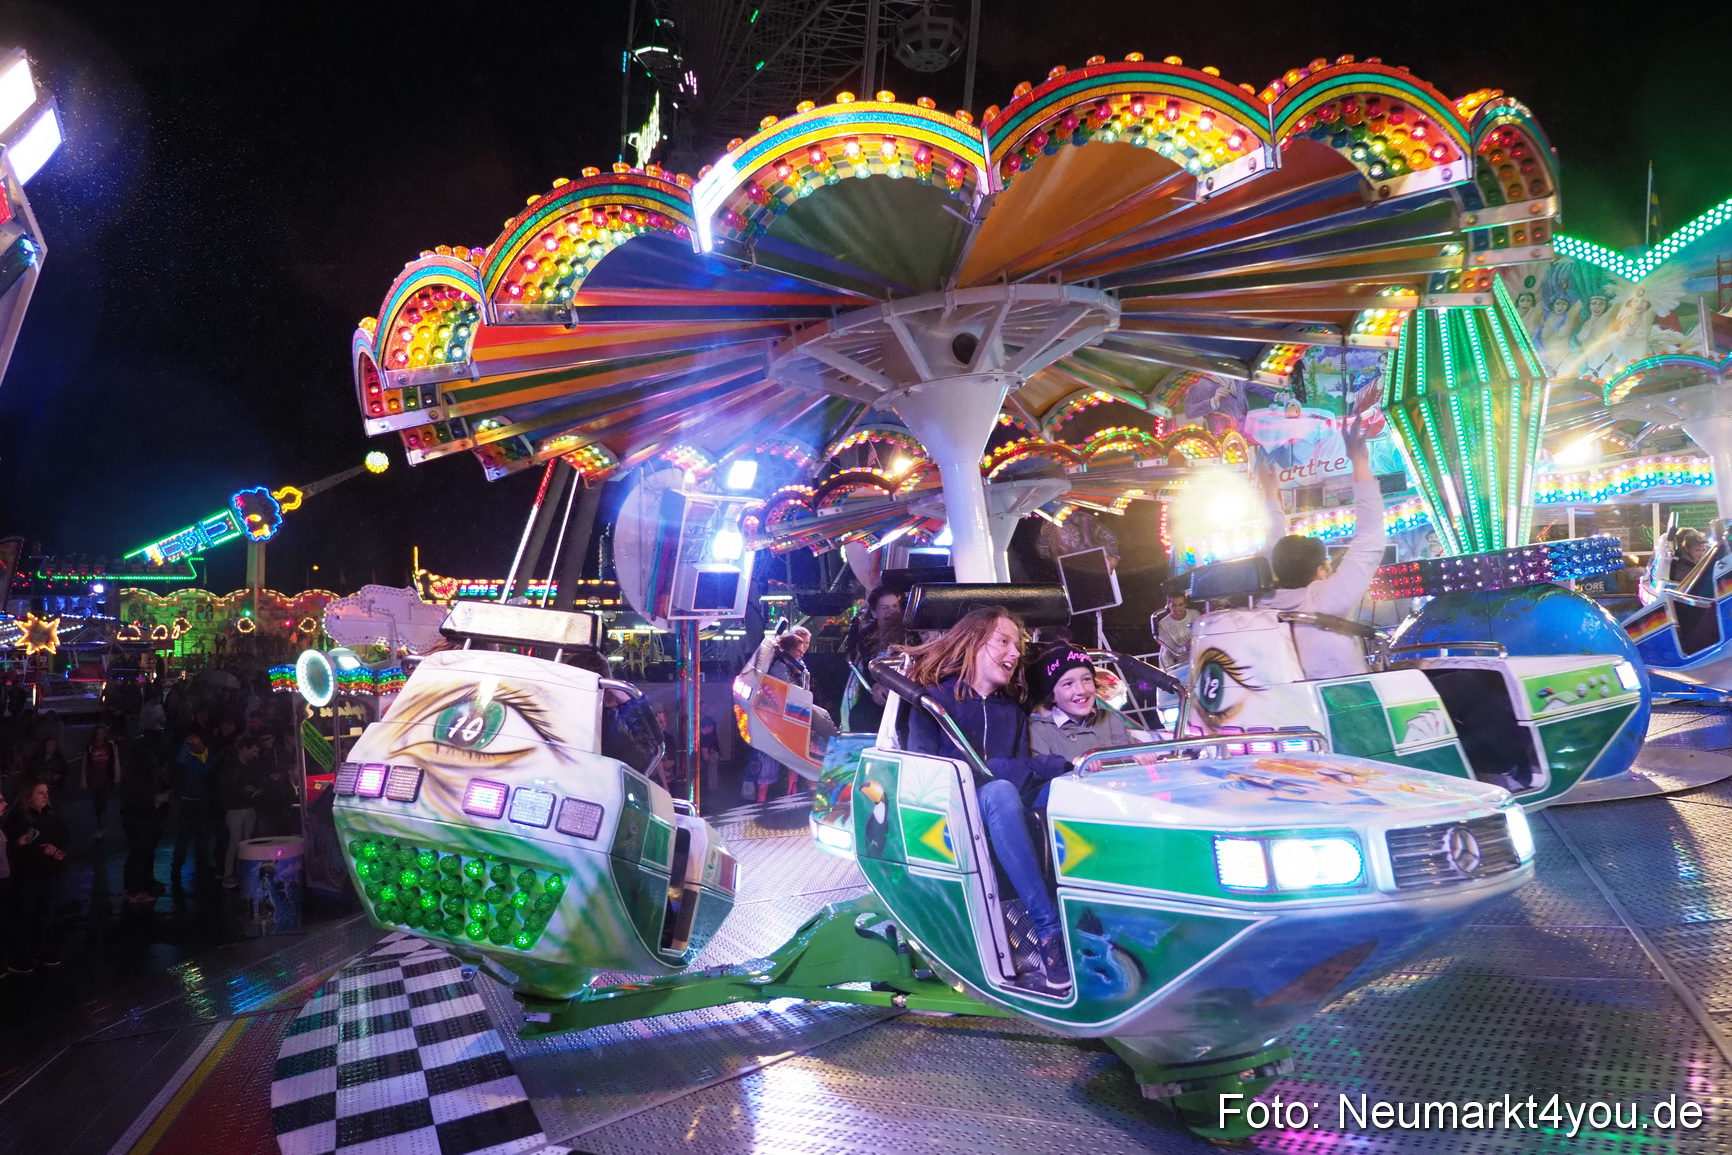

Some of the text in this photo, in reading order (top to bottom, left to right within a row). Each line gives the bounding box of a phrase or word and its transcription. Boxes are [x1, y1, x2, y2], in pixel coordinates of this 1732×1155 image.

[458, 584, 498, 597] LOVE
[1046, 659, 1060, 676] Los
[1203, 676, 1220, 699] 12
[447, 715, 484, 741] 10
